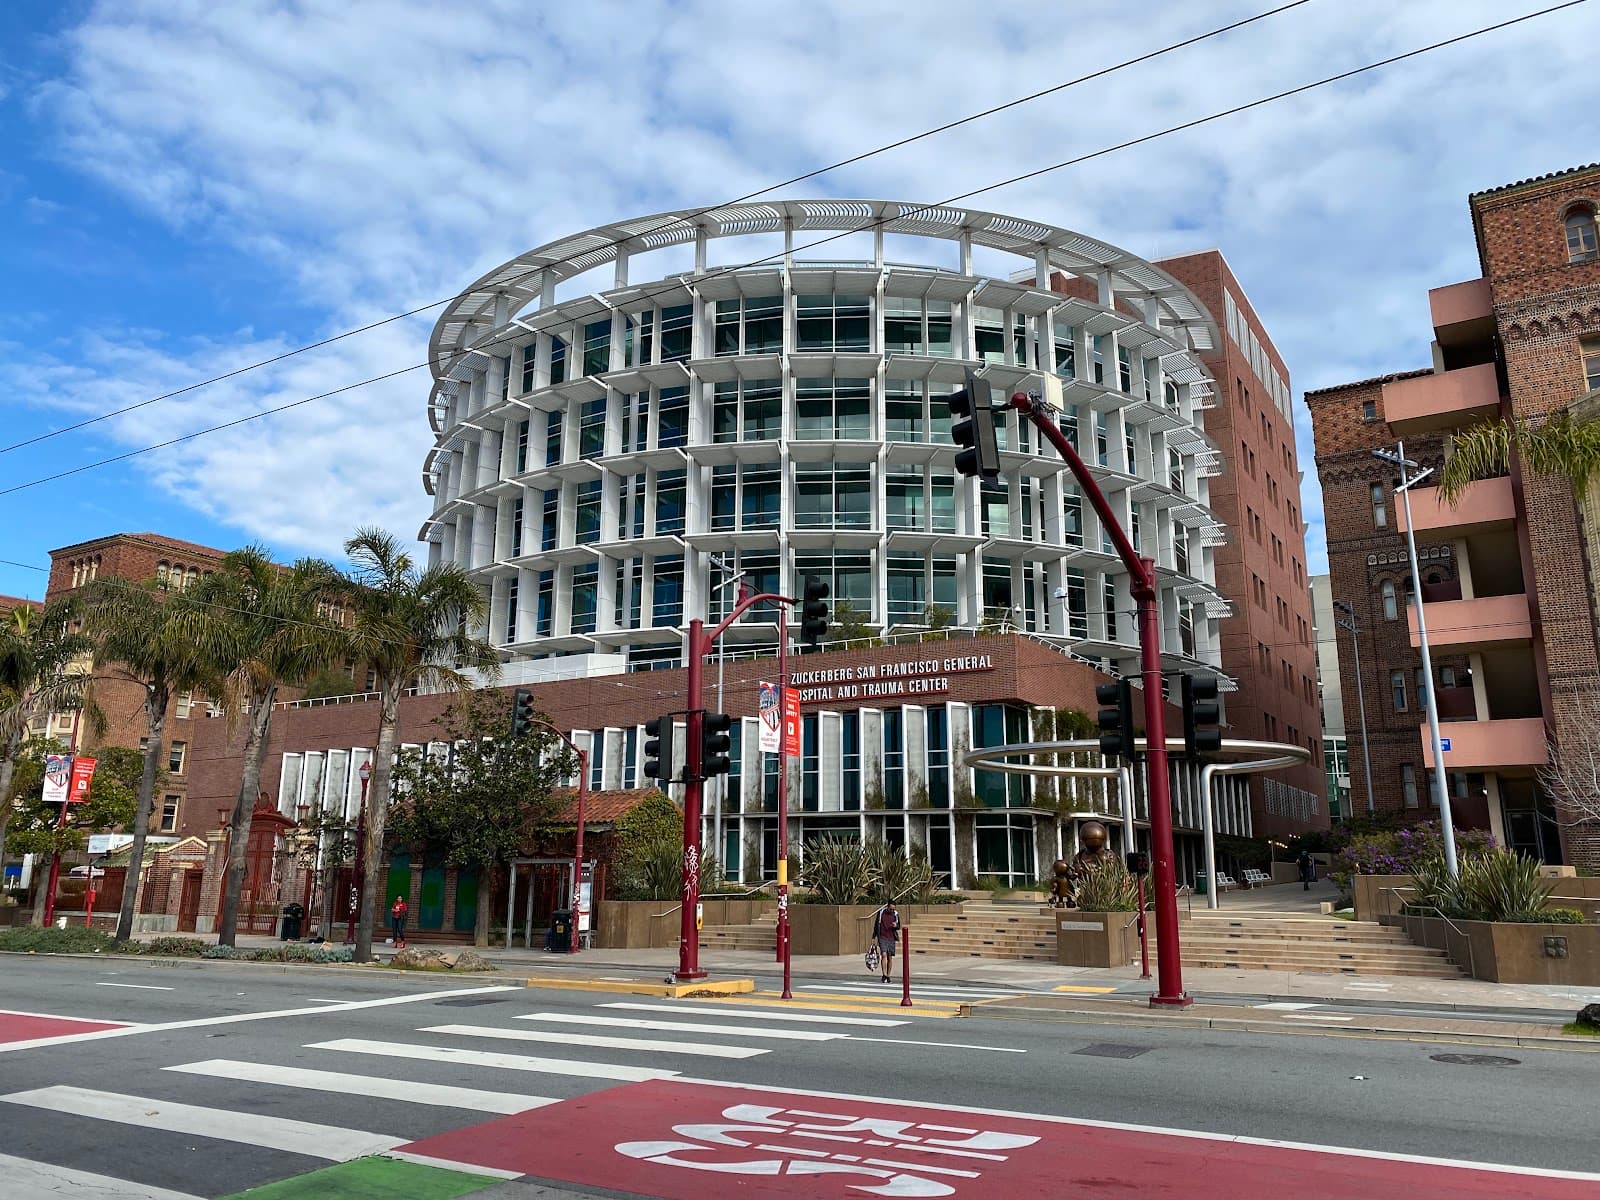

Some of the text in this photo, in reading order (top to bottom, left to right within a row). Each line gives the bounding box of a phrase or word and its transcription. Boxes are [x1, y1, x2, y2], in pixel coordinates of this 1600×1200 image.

[791, 656, 993, 684] ZUCKERBERG SAN FRANCISCO GENERAL
[798, 688, 833, 701] OSPITAL
[837, 685, 858, 698] AND
[862, 682, 904, 696] TRAUMA
[909, 678, 948, 692] CENTER
[614, 1103, 1042, 1197] BUS
